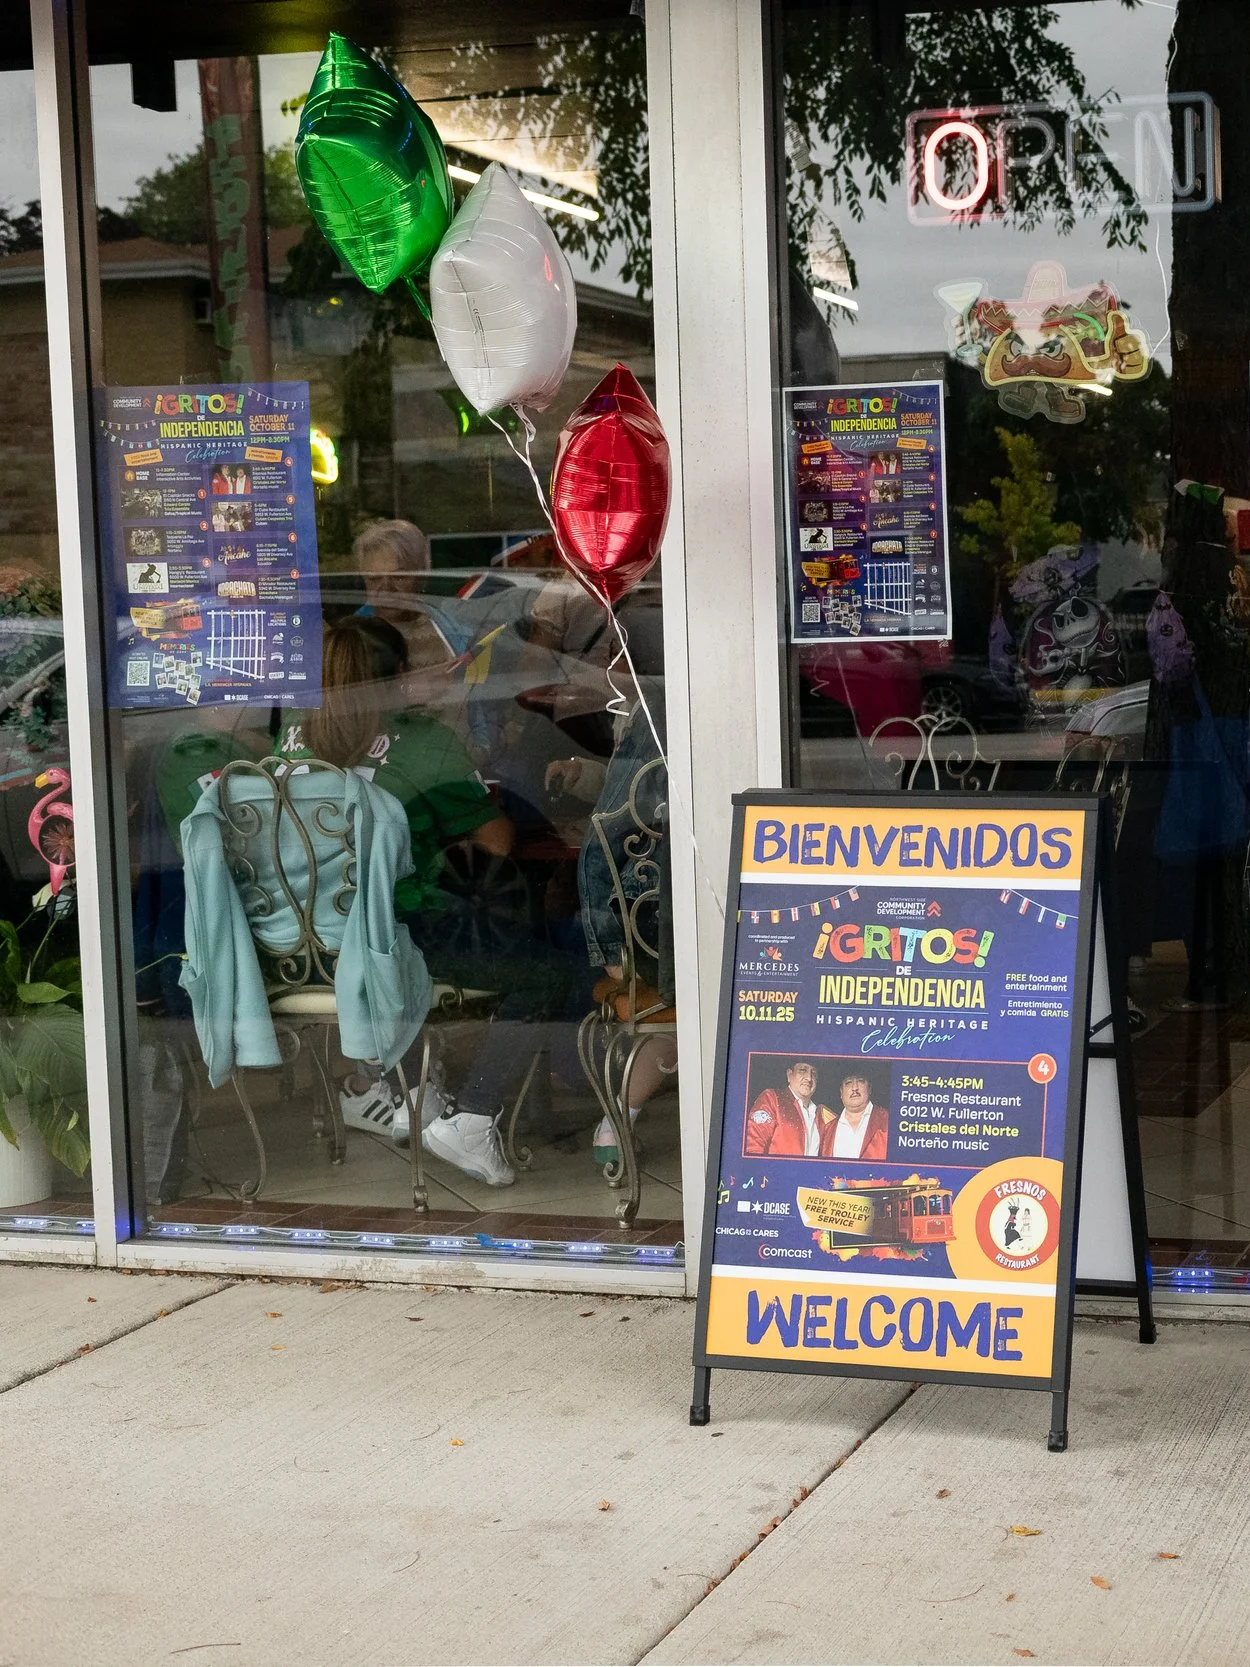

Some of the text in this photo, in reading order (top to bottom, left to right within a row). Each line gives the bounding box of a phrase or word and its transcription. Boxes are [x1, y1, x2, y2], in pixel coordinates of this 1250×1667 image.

[923, 106, 1196, 211] OPEN
[154, 393, 245, 415] ¡GRITOS!
[826, 397, 898, 415] ¡GRITOS!
[249, 414, 289, 423] SATURDAY
[831, 417, 897, 432] INDEPENDENCIA
[160, 420, 245, 438] INDEPENDENCIA
[249, 422, 296, 432] OCTOBER 11
[185, 446, 231, 463] Celebration
[752, 820, 1072, 869] BIENVENIDOS
[813, 922, 994, 968] ¡GRITOS!
[739, 962, 799, 972] MERCEDES
[896, 966, 911, 975] DE
[1006, 973, 1067, 983] FREE food and
[819, 975, 985, 1008] INDEPENDENCIA
[1005, 983, 1067, 992] entertainment
[738, 990, 799, 1003] SATURDAY
[1008, 1000, 1062, 1009] Entretimiento
[739, 1005, 795, 1022] 10.11.25
[1000, 1009, 1005, 1017] y
[1007, 1009, 1036, 1017] comida
[816, 1015, 988, 1030] HISPANIC HERITAGE
[861, 1026, 955, 1053] Celebration
[1037, 1059, 1050, 1076] 4
[901, 1091, 1021, 1107] Fresnos Restaurant
[900, 1106, 1004, 1121] 6012 W. Fullerton
[899, 1121, 1019, 1137] Cristales del Norte
[898, 1136, 990, 1151] Norteño music
[994, 1180, 1047, 1201] FRESNOS
[763, 1202, 790, 1215] DCASE
[807, 1196, 871, 1212] NEW THIS YEAR!
[805, 1204, 870, 1221] FREE TROLLEY
[817, 1214, 855, 1227] SERVICE
[752, 1228, 779, 1238] CARES
[995, 1253, 1039, 1269] RESTAURANT
[747, 1290, 1023, 1361] WELCOME
